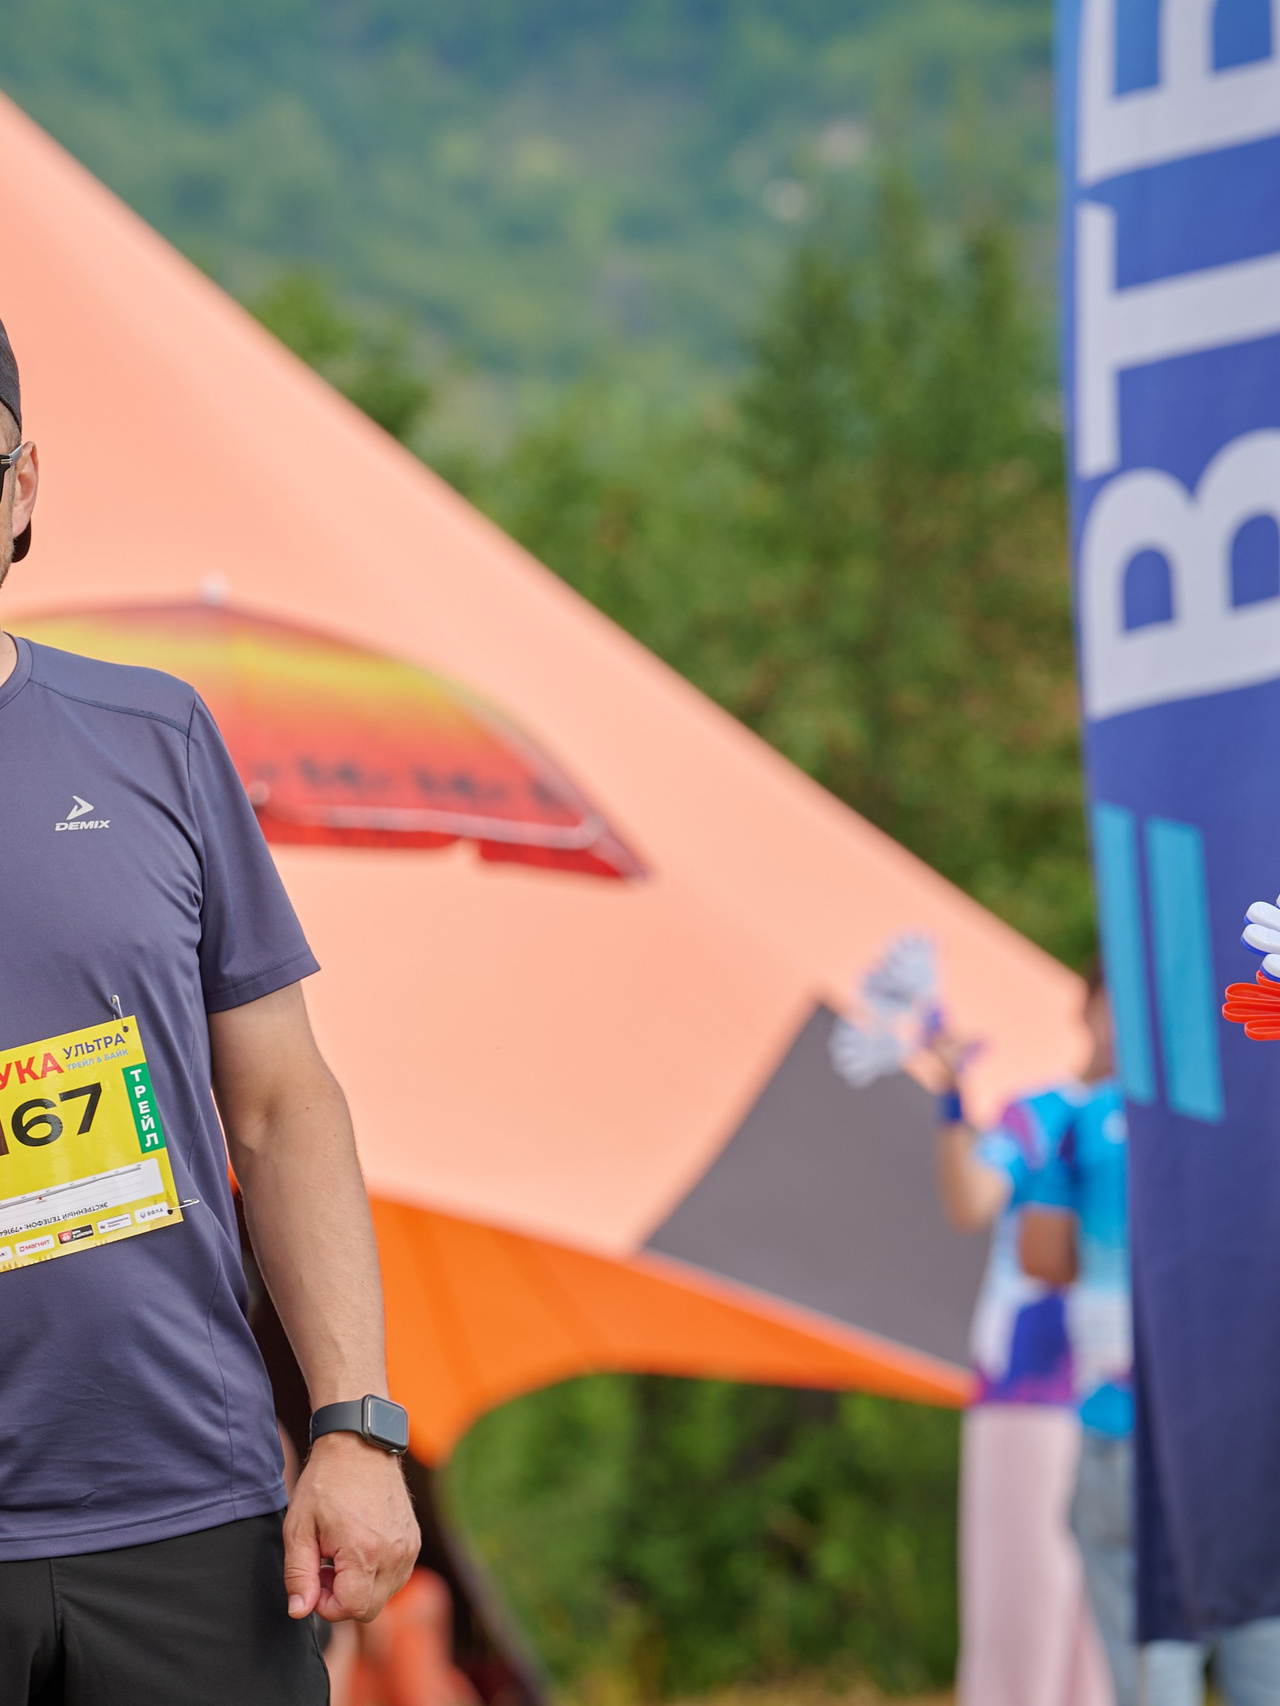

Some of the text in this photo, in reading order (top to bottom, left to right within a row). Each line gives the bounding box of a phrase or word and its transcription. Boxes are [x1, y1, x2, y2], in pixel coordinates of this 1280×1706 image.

[55, 820, 111, 831] DEMIX
[62, 1033, 126, 1060] УЛЬТРА
[67, 1058, 95, 1071] ТРЕЙЛ
[104, 1048, 129, 1061] БАЙК
[129, 1068, 160, 1148] ТРЕЙЛ
[62, 1202, 108, 1221] ЭКСТРЕННЫЙ
[25, 1215, 61, 1230] ТЕЛЕФОН:
